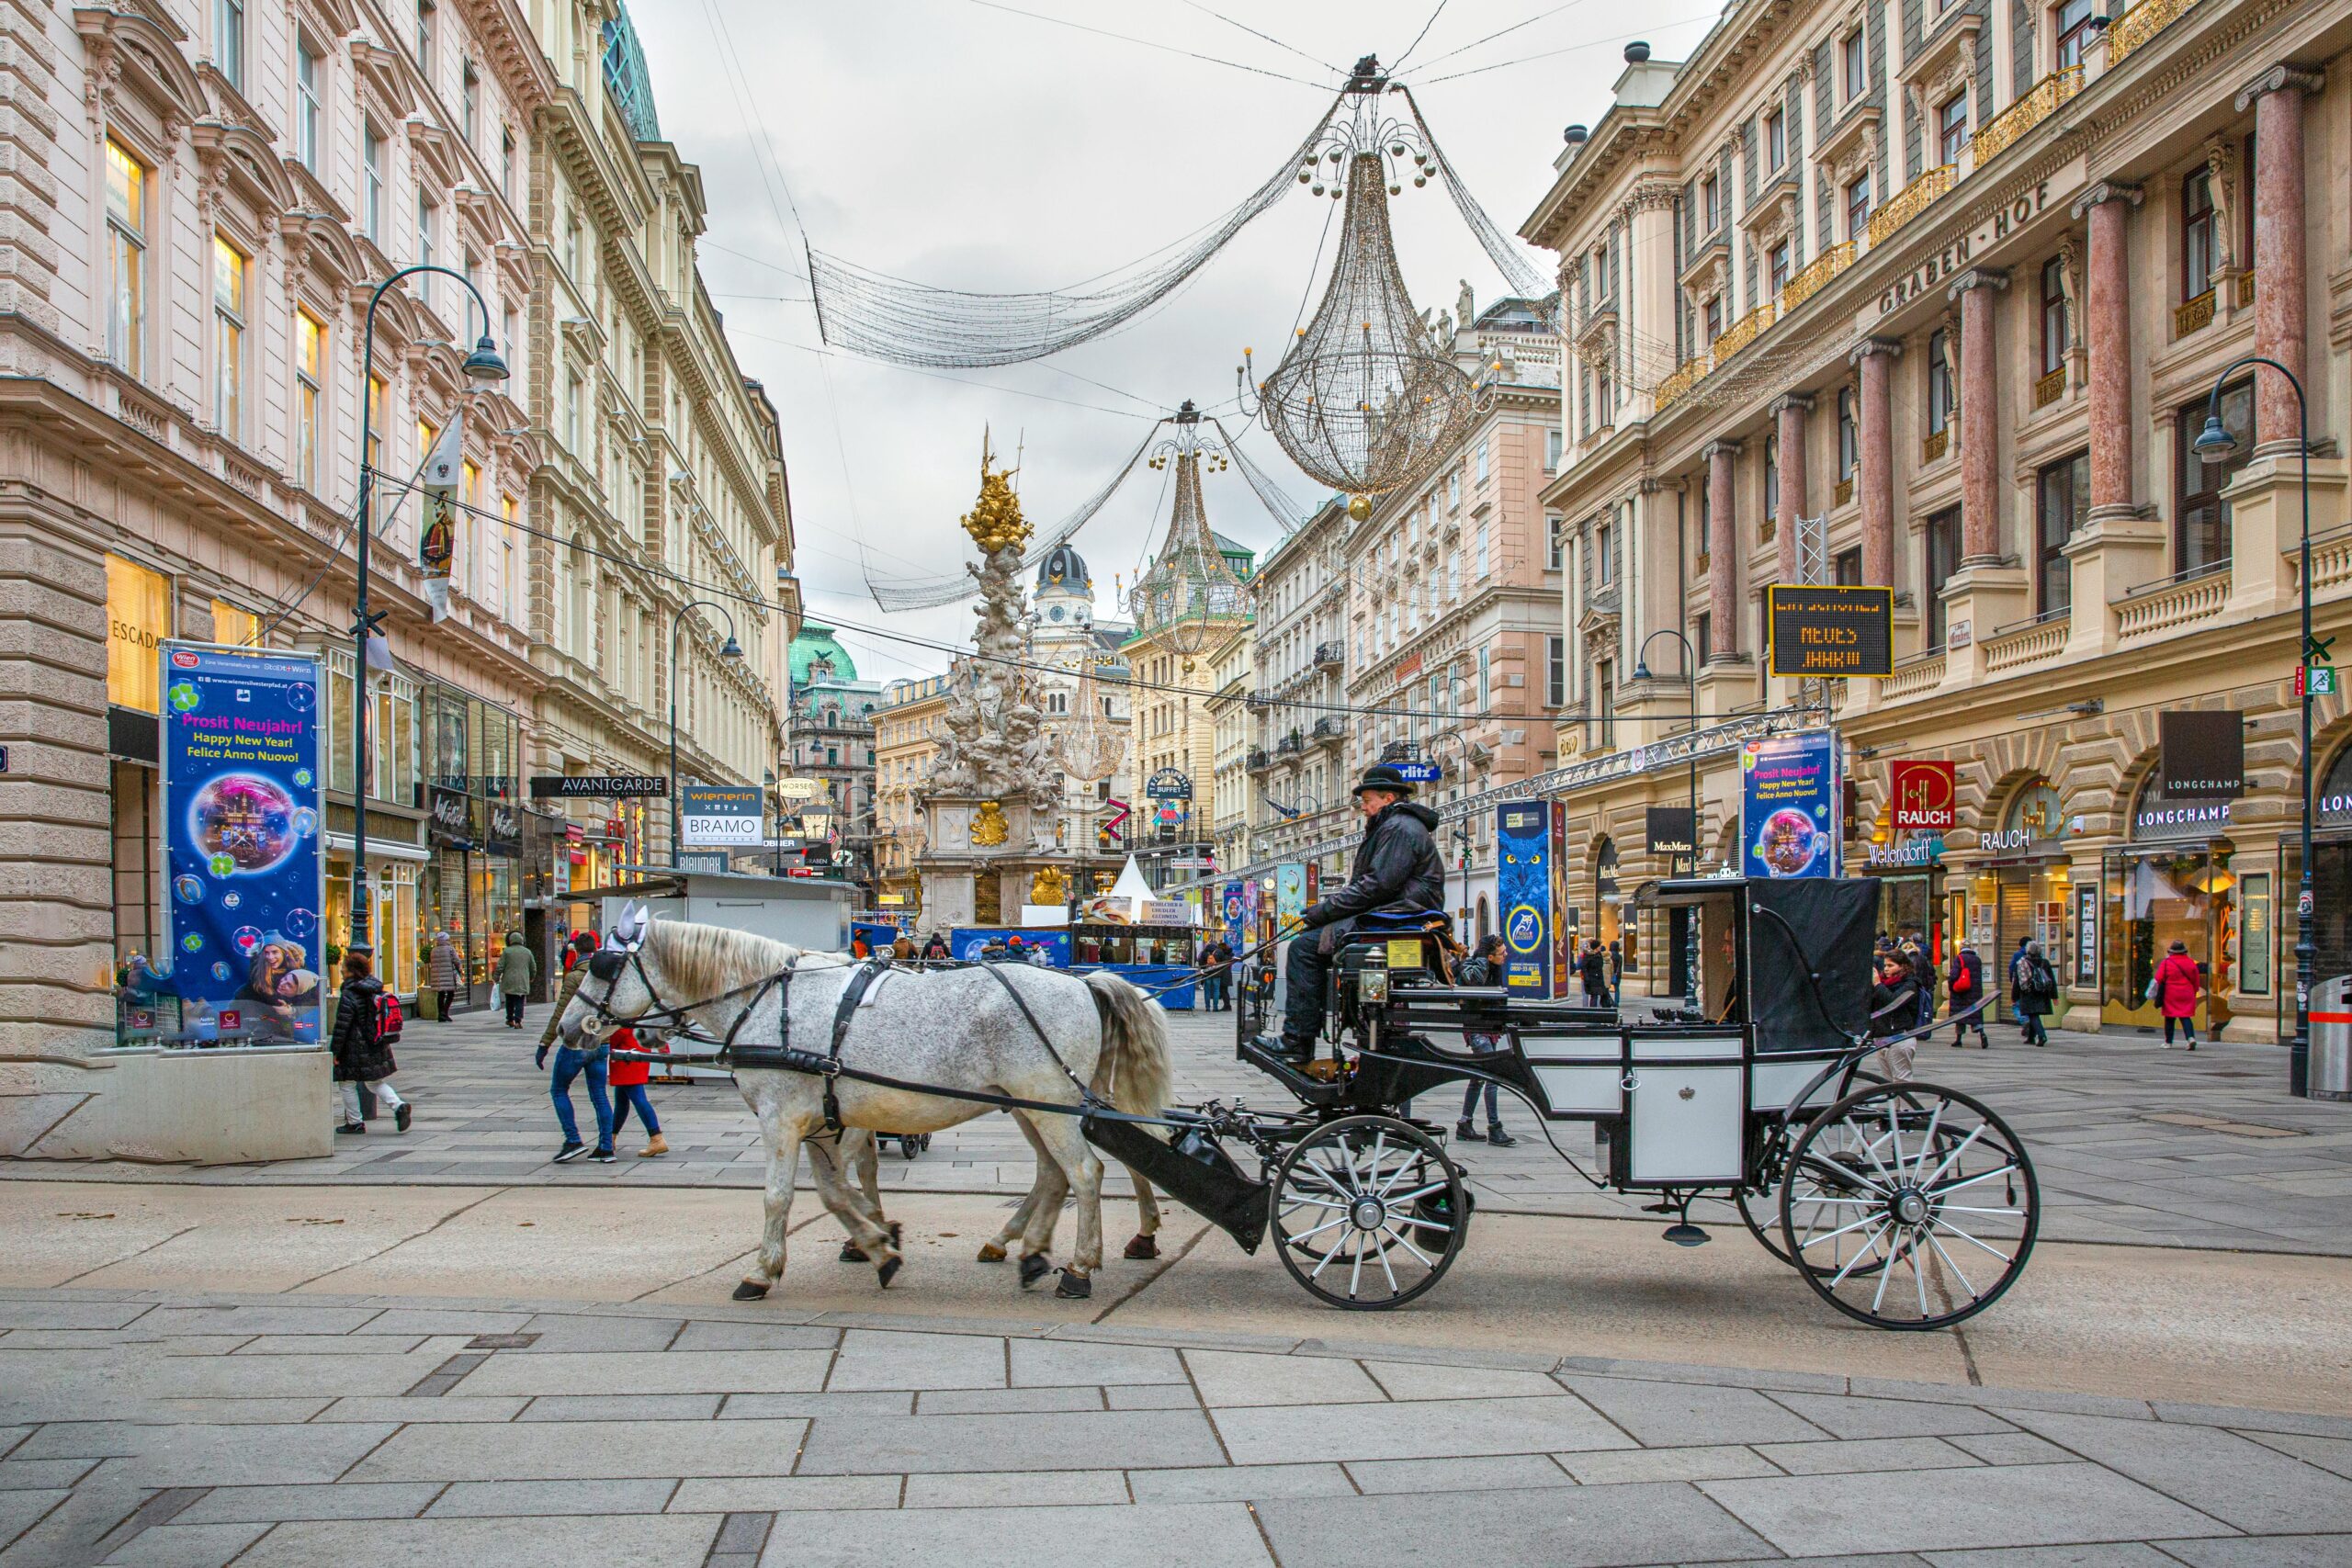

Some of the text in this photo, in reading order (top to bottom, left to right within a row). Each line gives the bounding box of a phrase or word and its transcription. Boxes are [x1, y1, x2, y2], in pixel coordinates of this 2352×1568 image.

[1878, 182, 2049, 315] GRABEN HOF
[176, 652, 196, 661] Wien
[212, 678, 288, 689] www.wienersilvesterpfad.at
[182, 714, 303, 736] Prosit Neujahr!
[193, 732, 293, 748] Happy New Year!
[187, 747, 299, 762] Felice Anno Nuovo!
[1398, 765, 1430, 778] rlitz
[1754, 764, 1820, 780] Prosit Neujahr!
[561, 778, 662, 791] AVANTGARDE
[1759, 778, 1815, 791] Happy New Year!
[2168, 780, 2241, 790] LONGCHAMP
[690, 792, 755, 801] wienerin
[1756, 788, 1818, 800] Felice Anno Nuovo!
[1898, 810, 1951, 824] RAUCH
[2138, 805, 2231, 826] LONGCHAMP
[690, 818, 755, 833] BRAMO
[1653, 840, 1691, 852] MaxMara
[1982, 829, 2030, 850] RAUCH
[1869, 838, 1931, 864] Wellendorff
